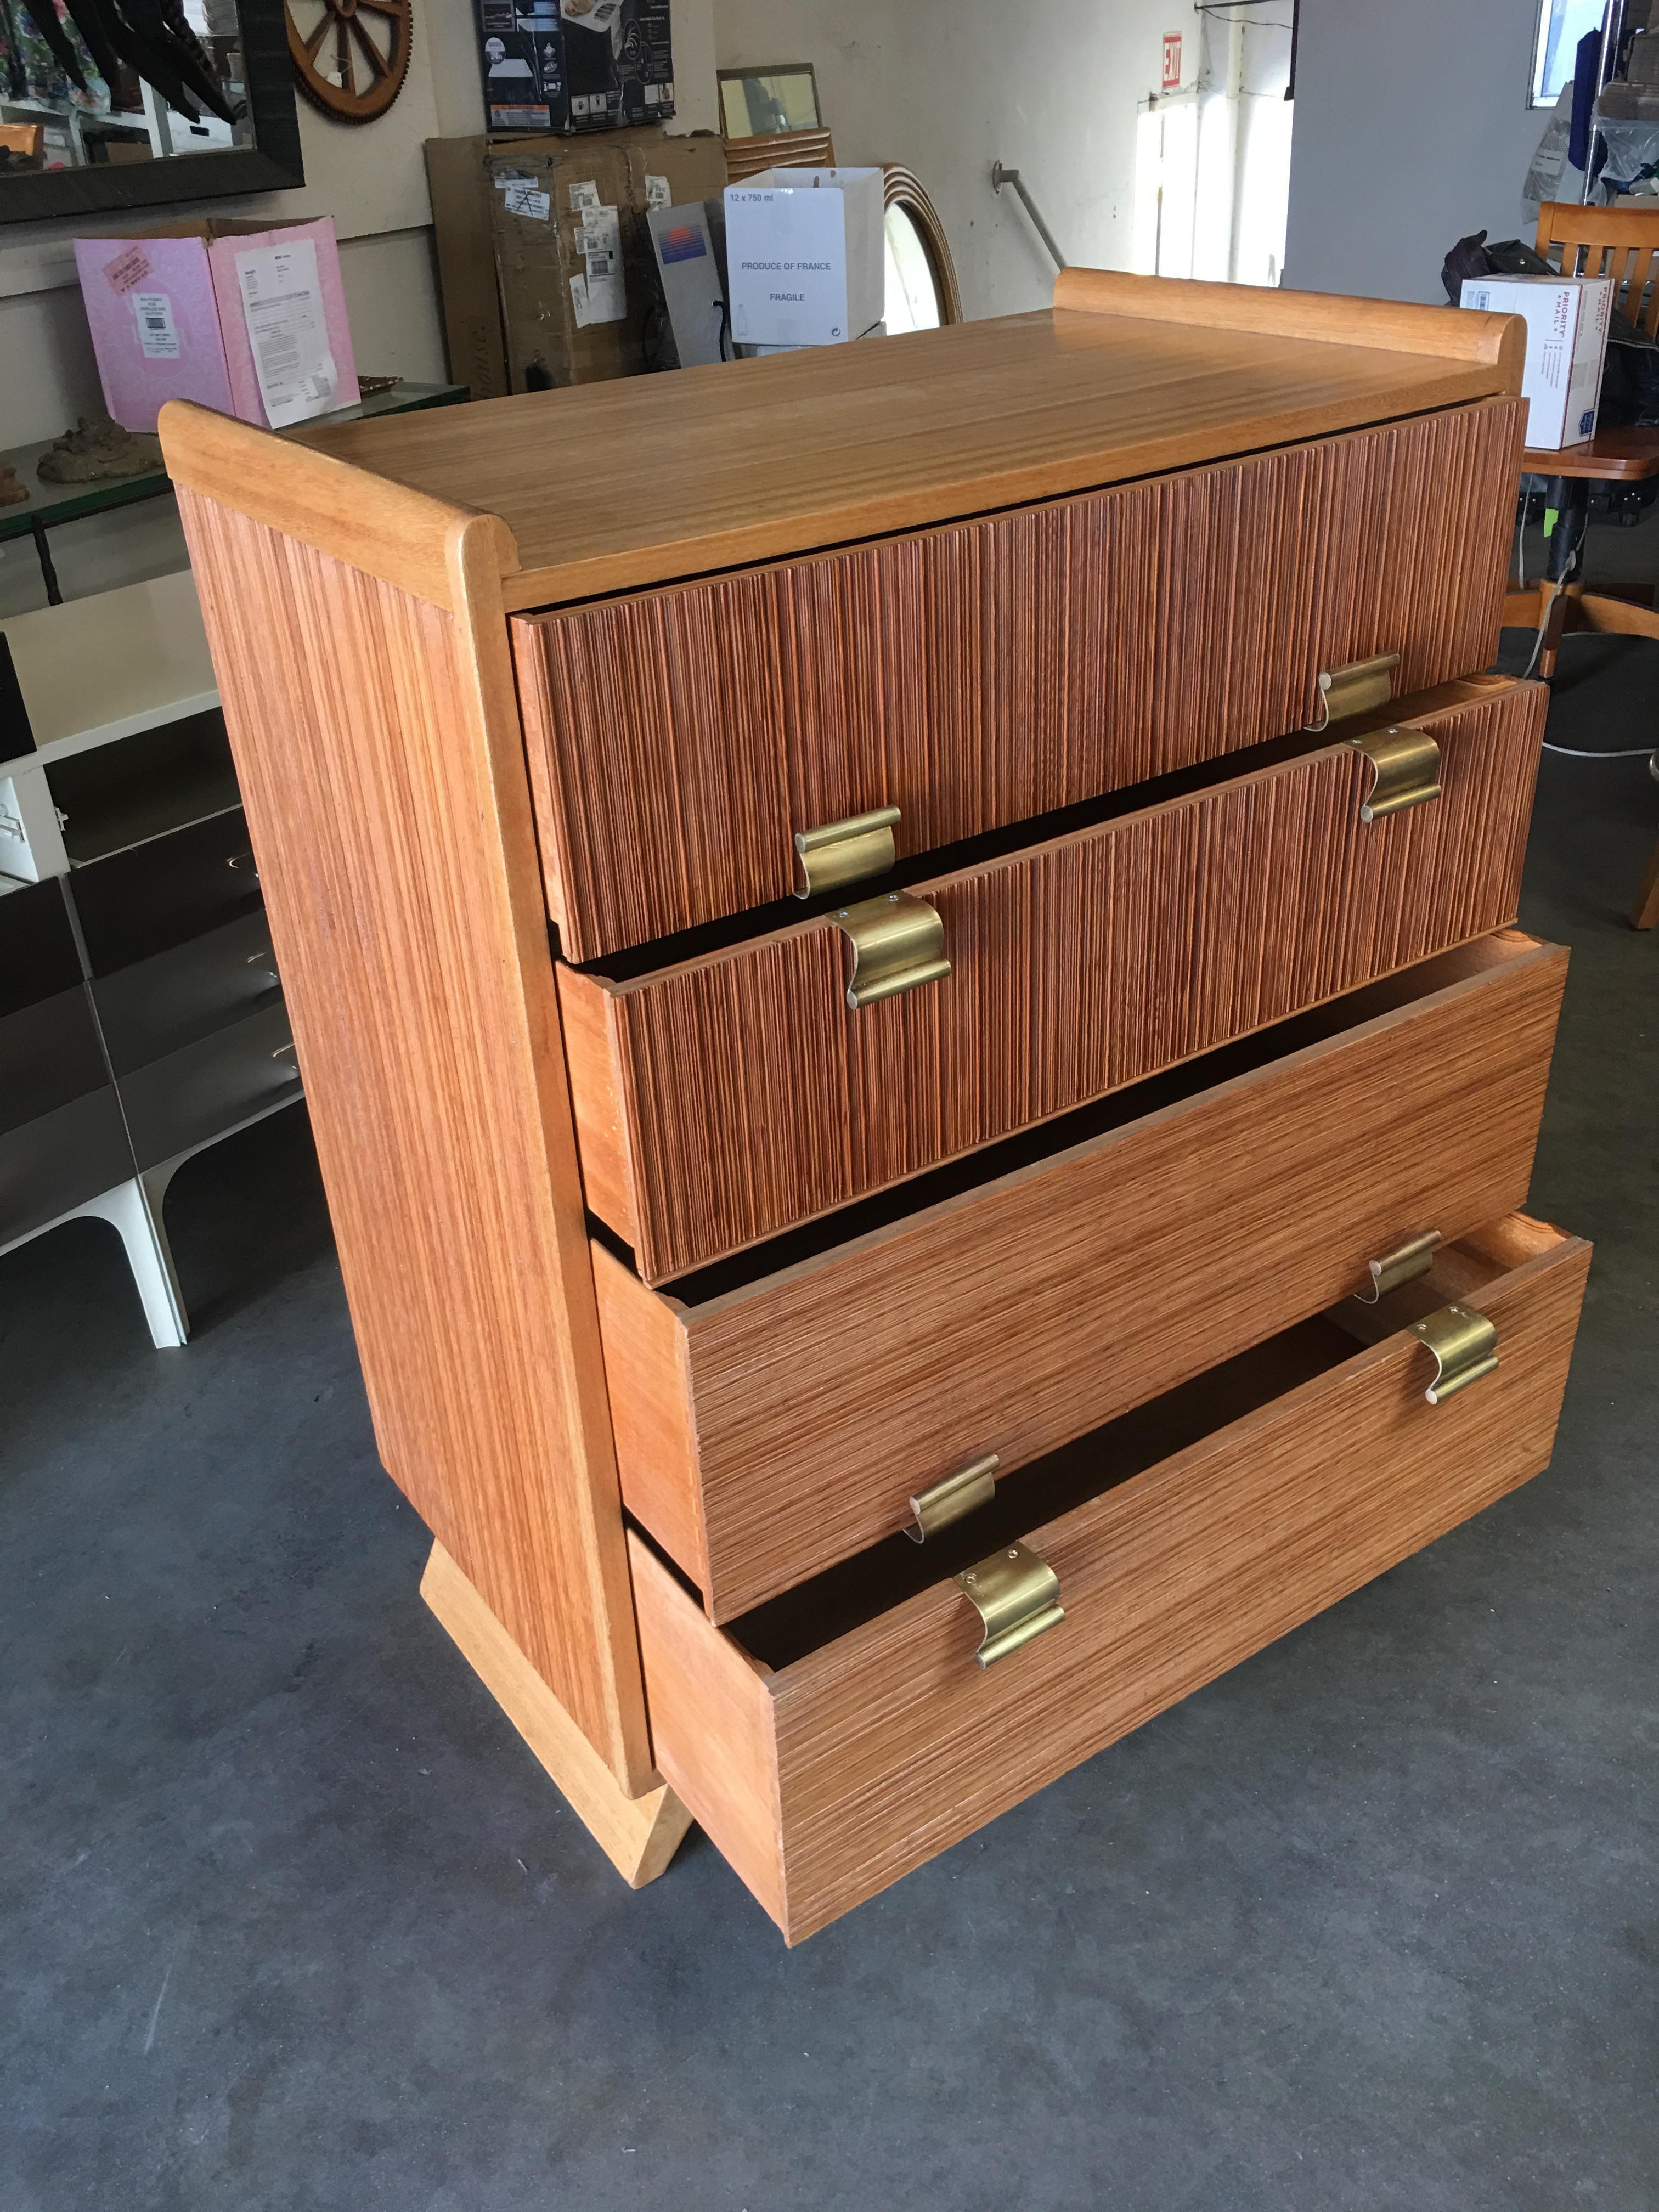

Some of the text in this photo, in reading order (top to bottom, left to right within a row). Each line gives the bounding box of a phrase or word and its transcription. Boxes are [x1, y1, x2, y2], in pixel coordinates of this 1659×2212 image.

[1163, 42, 1181, 81] EXIT
[730, 194, 740, 202] 12
[748, 194, 762, 202] 750
[764, 194, 774, 202] ml
[742, 262, 832, 270] PRODUCE OF FRANCE
[770, 293, 805, 301] FRAGILE
[1559, 291, 1570, 336] PRIORITY
[1598, 287, 1608, 332] PRIORITY
